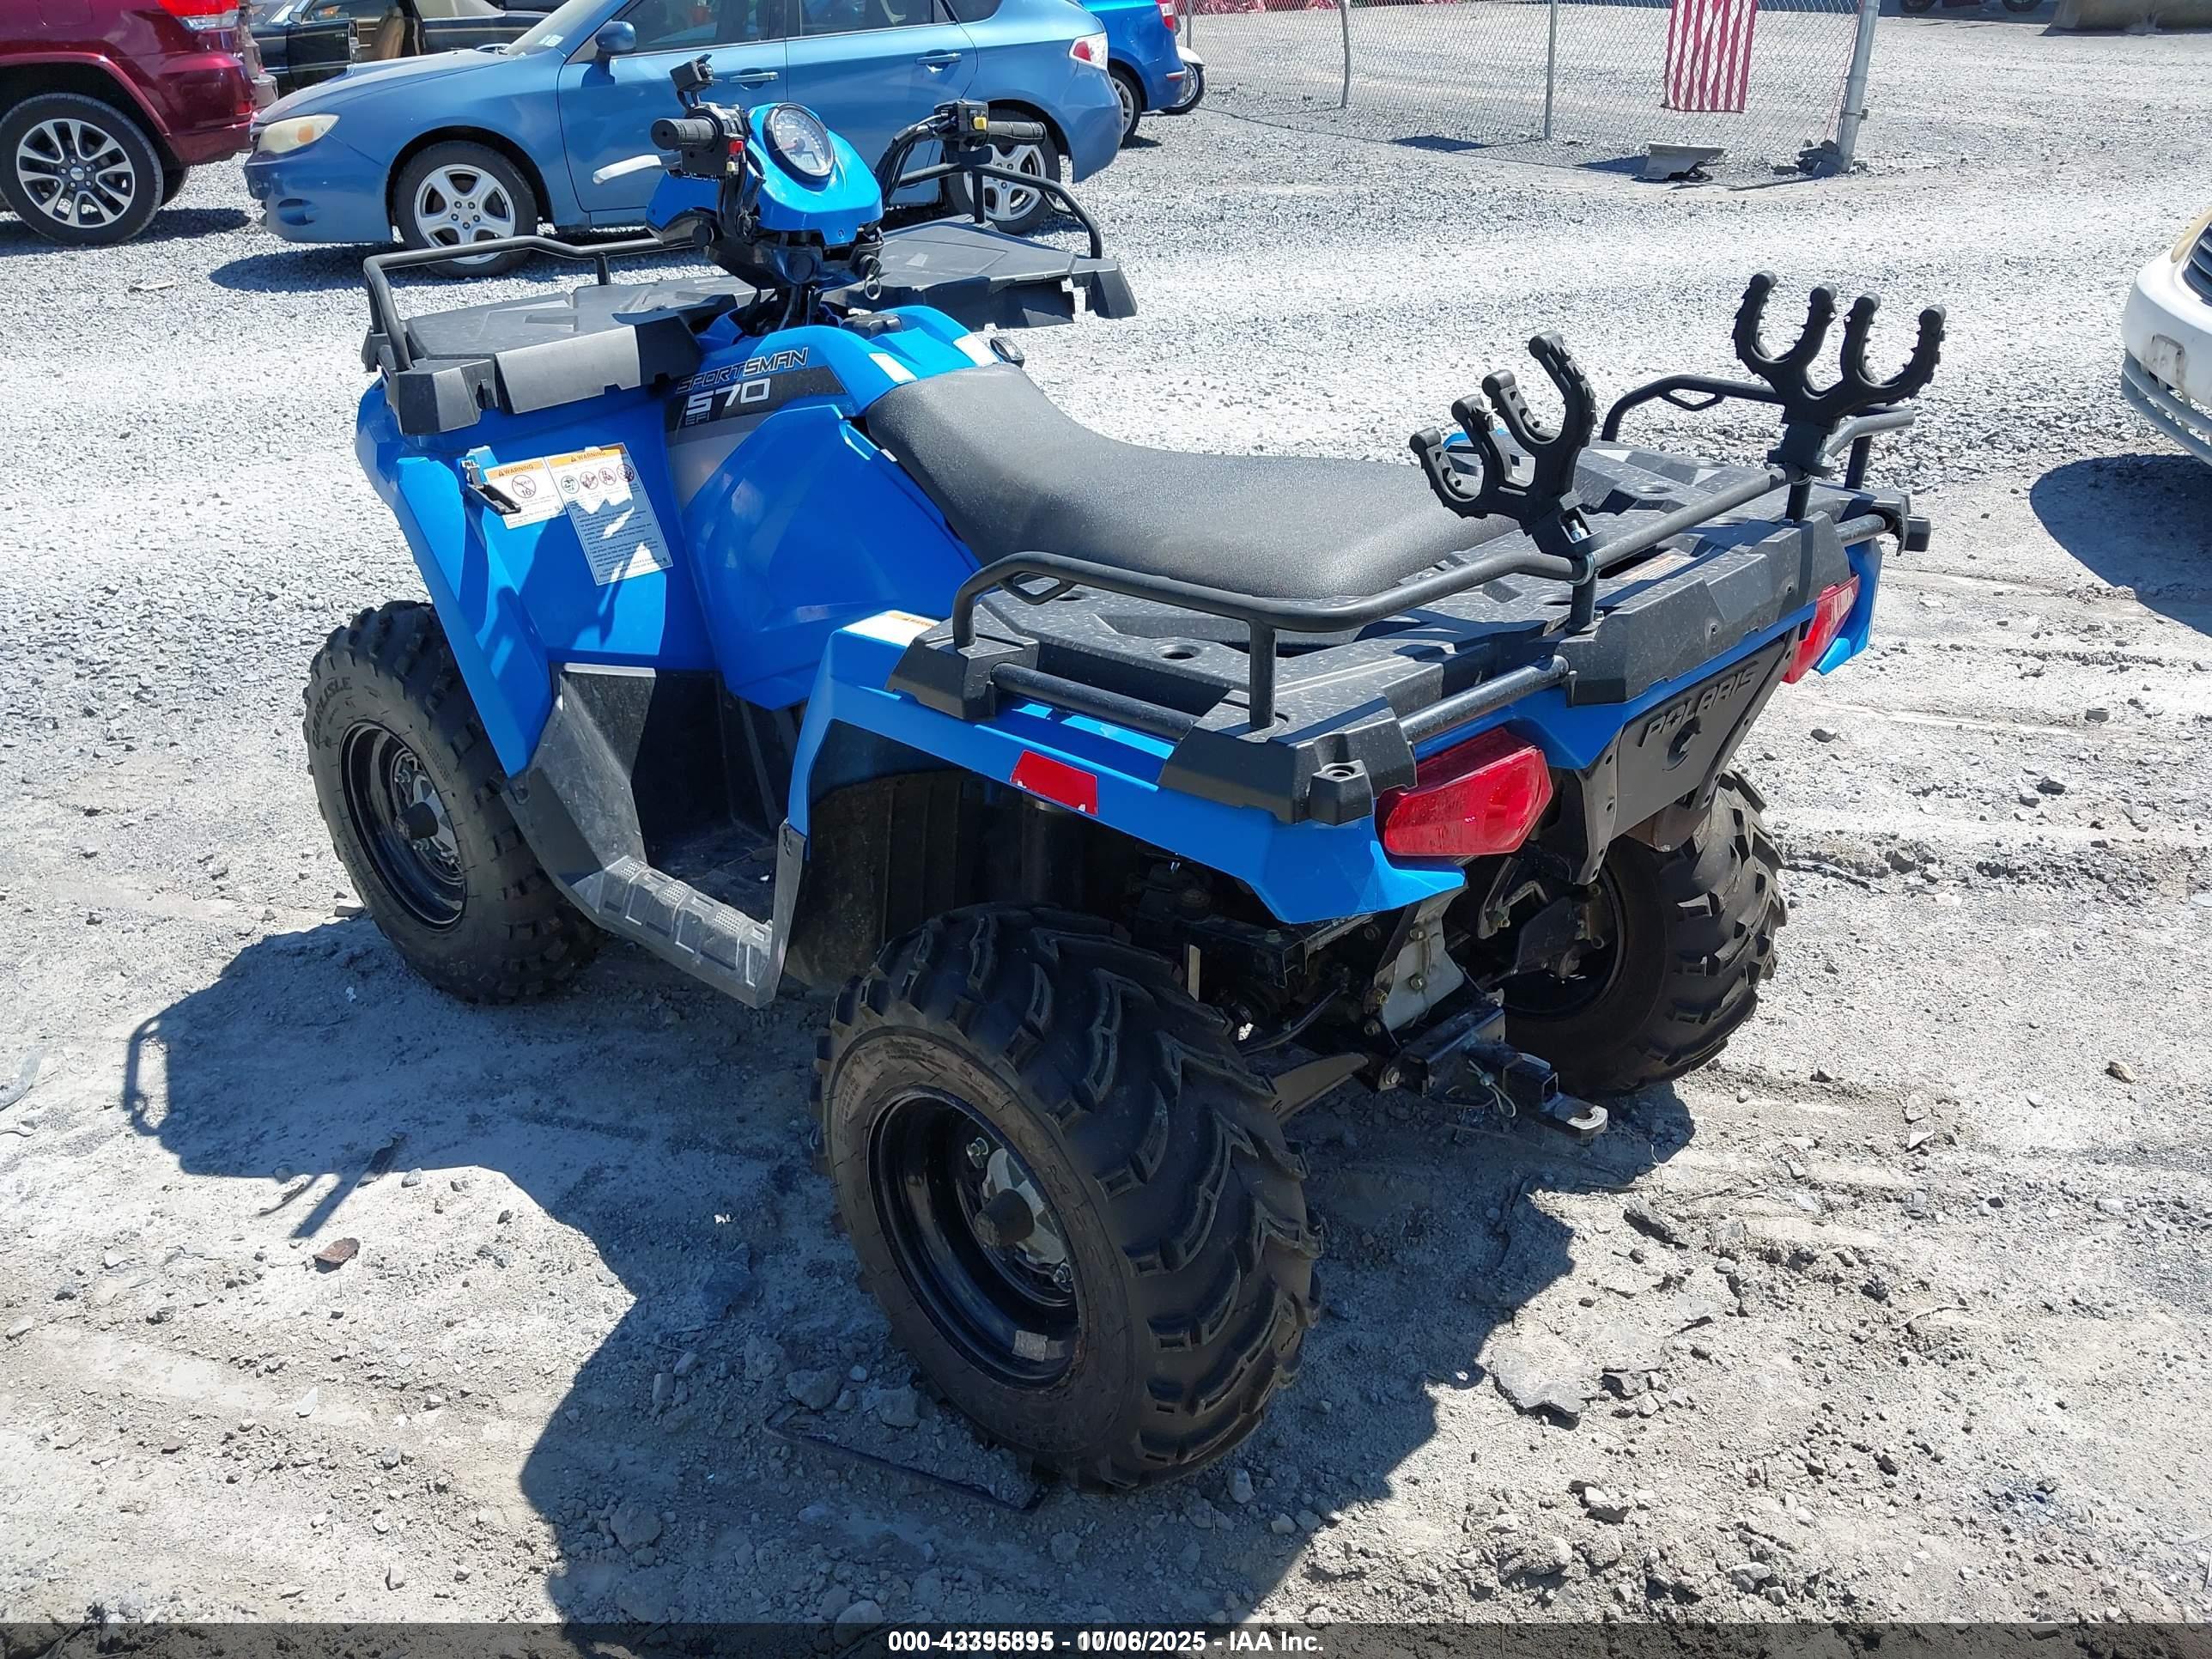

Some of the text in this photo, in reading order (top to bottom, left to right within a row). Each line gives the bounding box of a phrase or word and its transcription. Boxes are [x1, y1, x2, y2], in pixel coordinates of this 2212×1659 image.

[676, 347, 809, 394] SPORTSMAN
[685, 378, 770, 416] 570
[685, 412, 711, 426] EFI
[576, 449, 606, 461] WARNING
[504, 464, 534, 477] WARNING
[521, 488, 532, 497] 16
[312, 678, 352, 750] CARLISLE
[1638, 659, 1759, 748] POLARIS
